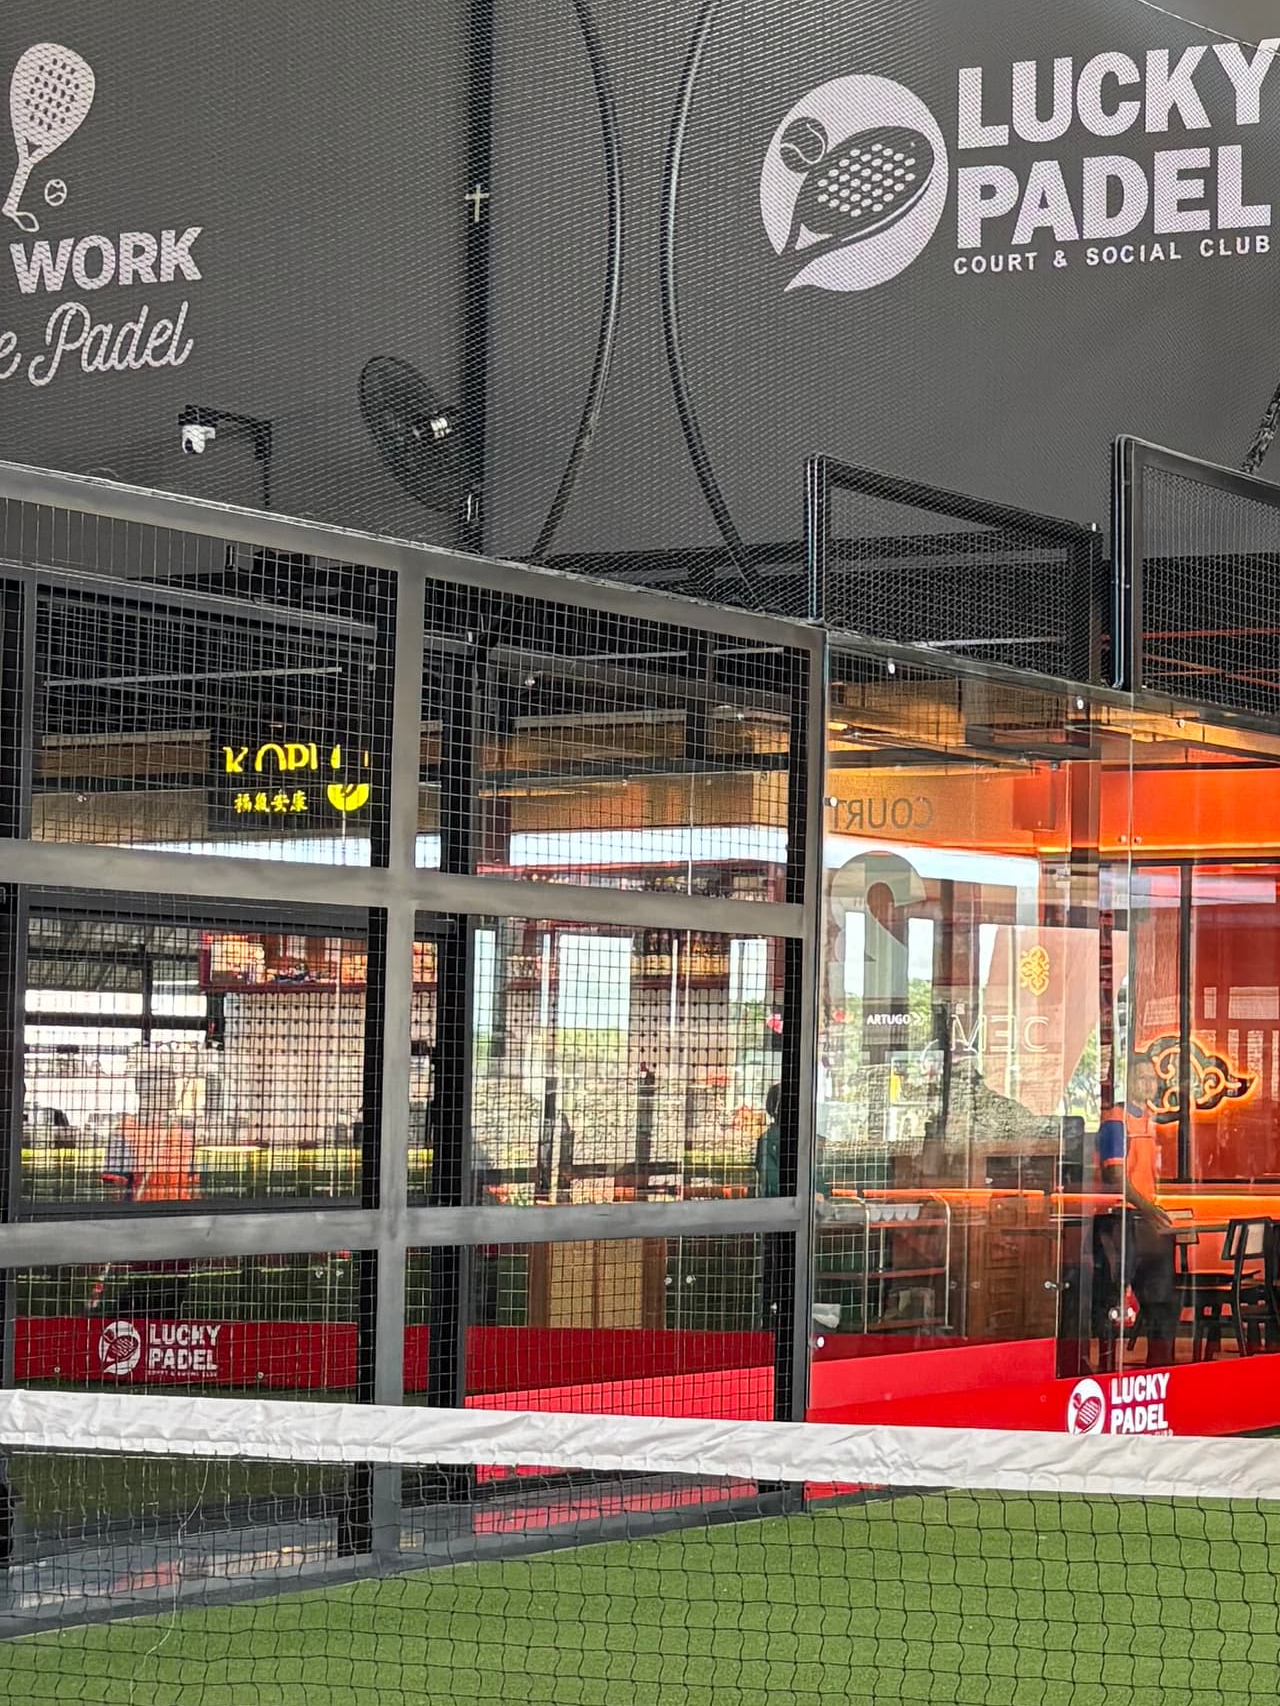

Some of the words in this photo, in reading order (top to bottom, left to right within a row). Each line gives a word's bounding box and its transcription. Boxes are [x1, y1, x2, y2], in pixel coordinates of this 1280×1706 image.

[954, 146, 1273, 250] PADEL
[9, 226, 204, 294] WORK
[953, 252, 1038, 275] COURT
[1053, 250, 1069, 270] &
[1086, 242, 1182, 266] SOCIAL
[1200, 235, 1271, 258] CLUB
[27, 301, 193, 387] Padel
[866, 1014, 911, 1026] ARTUGO
[149, 1324, 221, 1346] LUCKY
[148, 1348, 219, 1371] PADEL
[1111, 1372, 1170, 1405] LUCKY
[1110, 1403, 1169, 1435] PADEL
